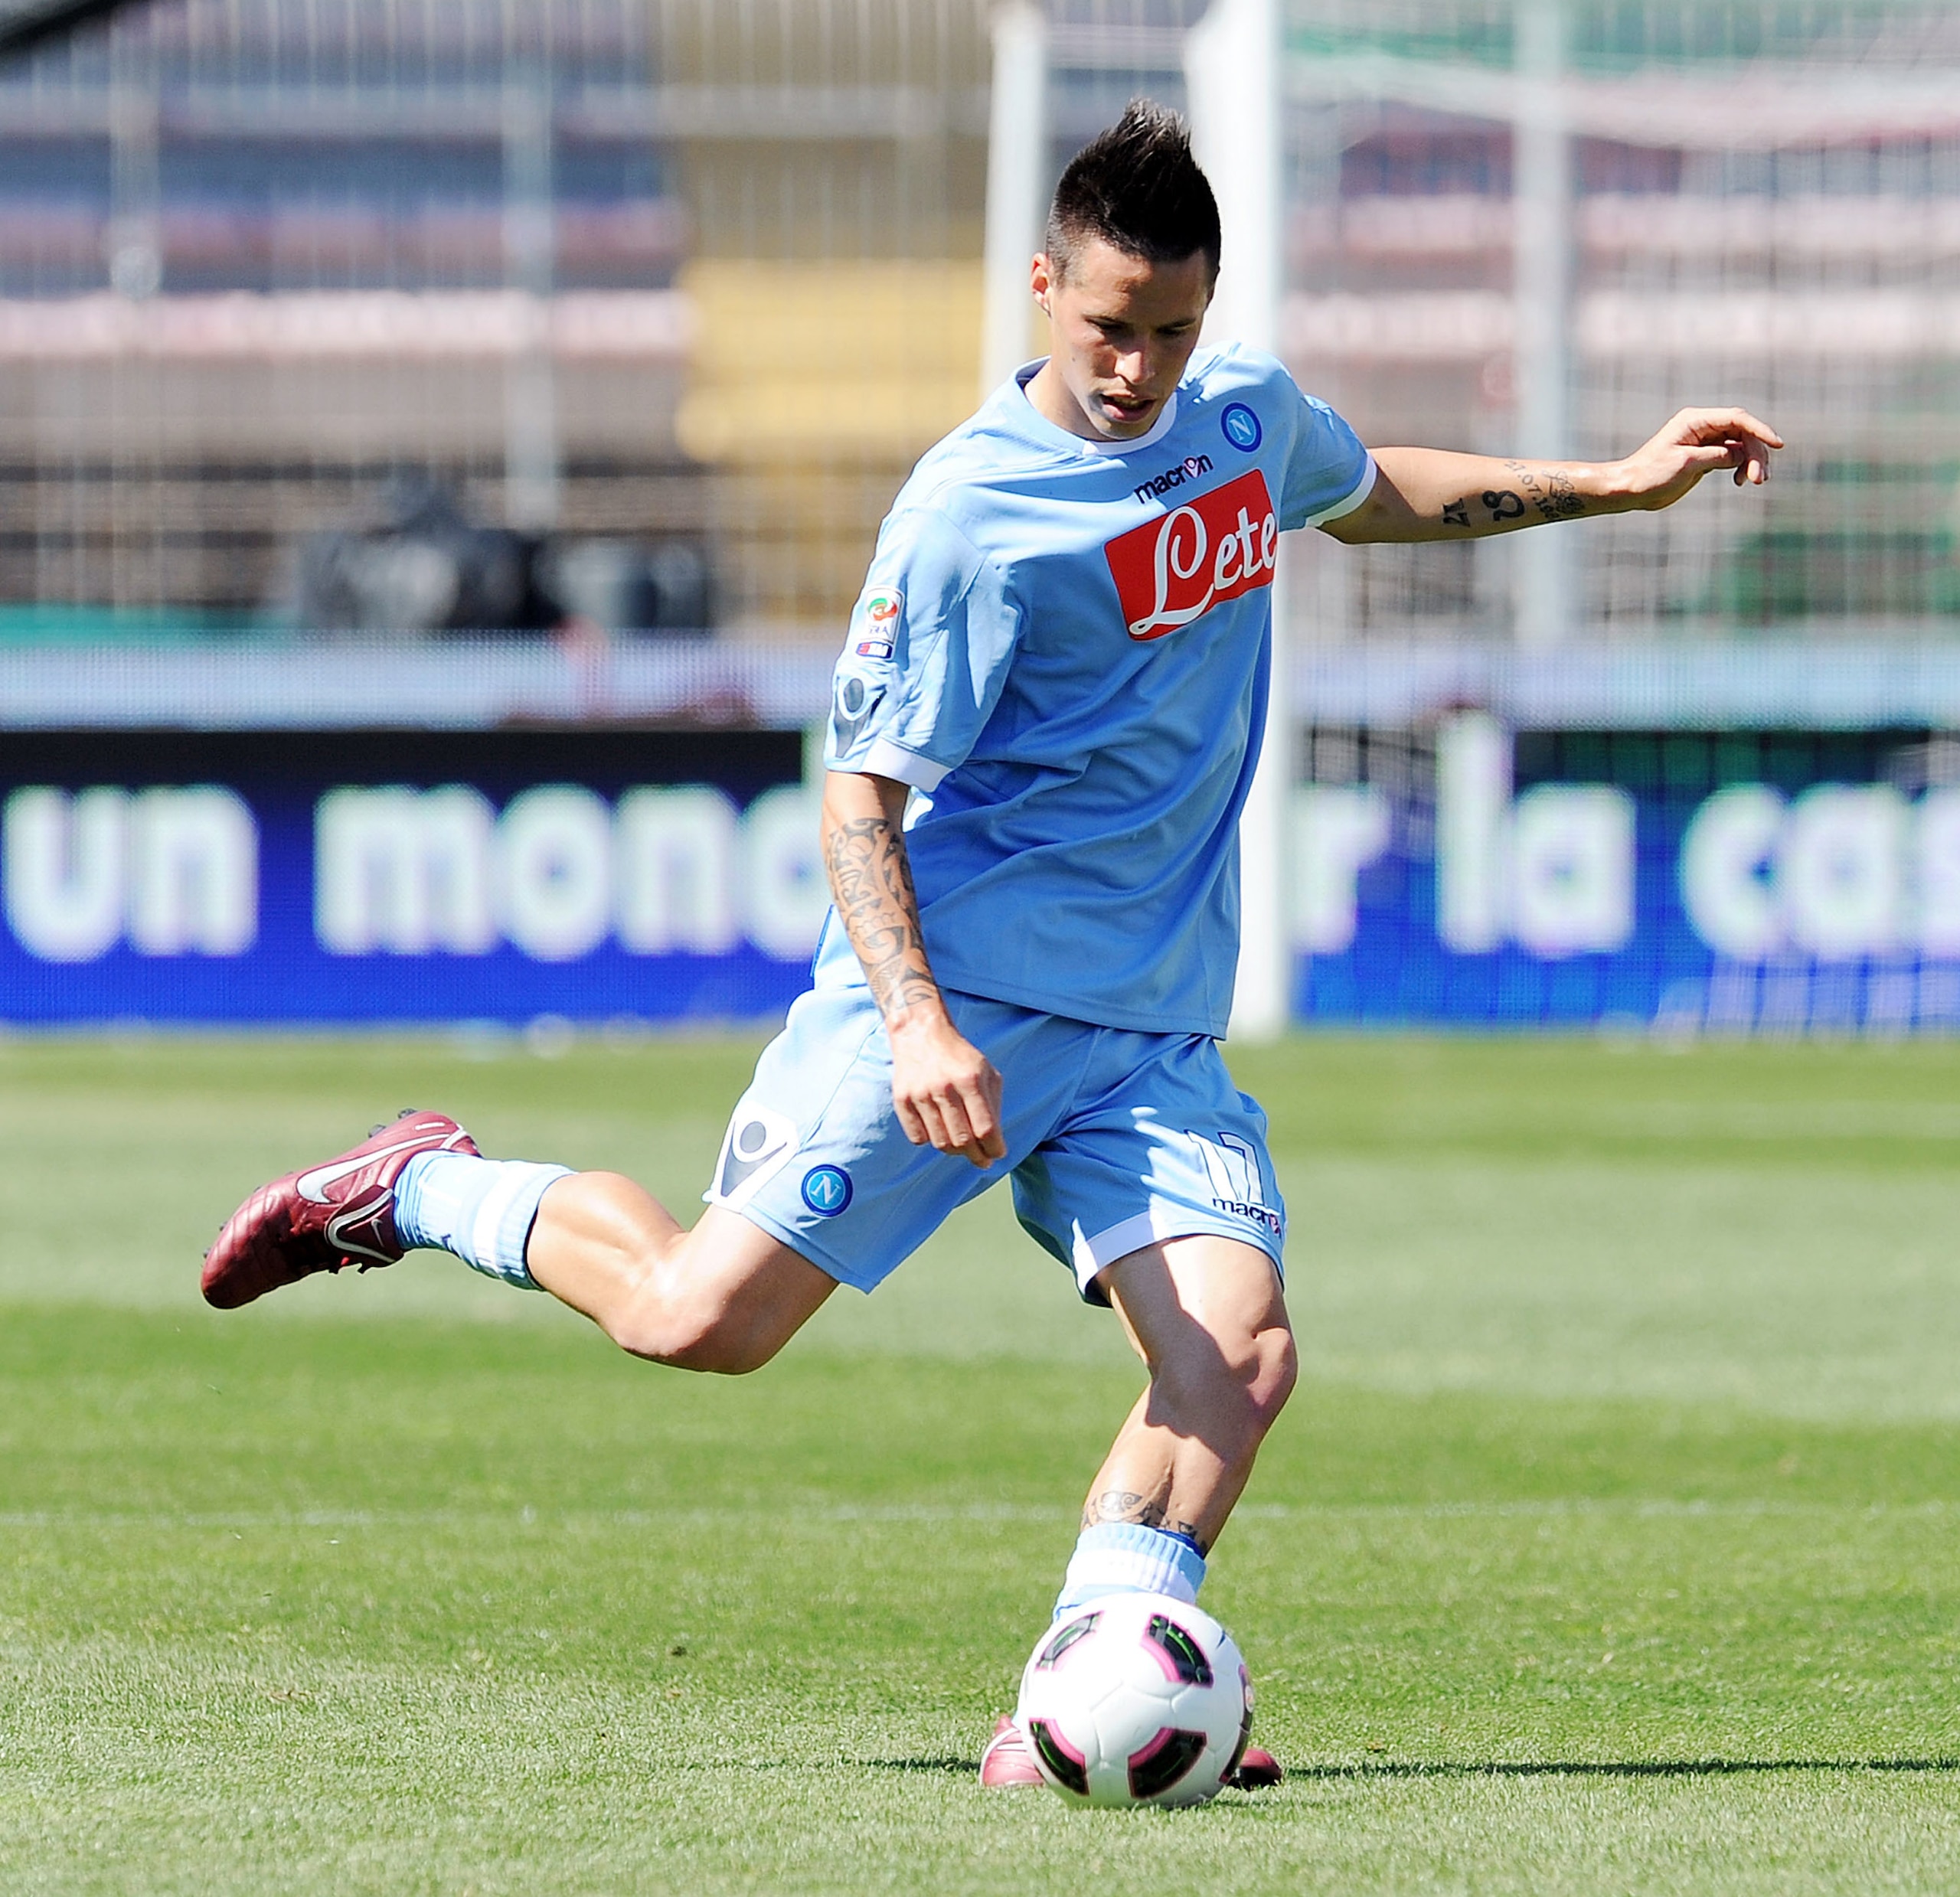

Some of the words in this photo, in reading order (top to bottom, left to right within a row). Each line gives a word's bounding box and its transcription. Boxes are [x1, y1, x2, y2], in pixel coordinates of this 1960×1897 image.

[1134, 454, 1214, 504] macron
[1129, 505, 1279, 635] Lete
[6, 782, 259, 963] un
[1434, 710, 1637, 959] la
[810, 1174, 842, 1205] N
[1184, 1128, 1266, 1207] 17
[1212, 1197, 1282, 1236] macro
